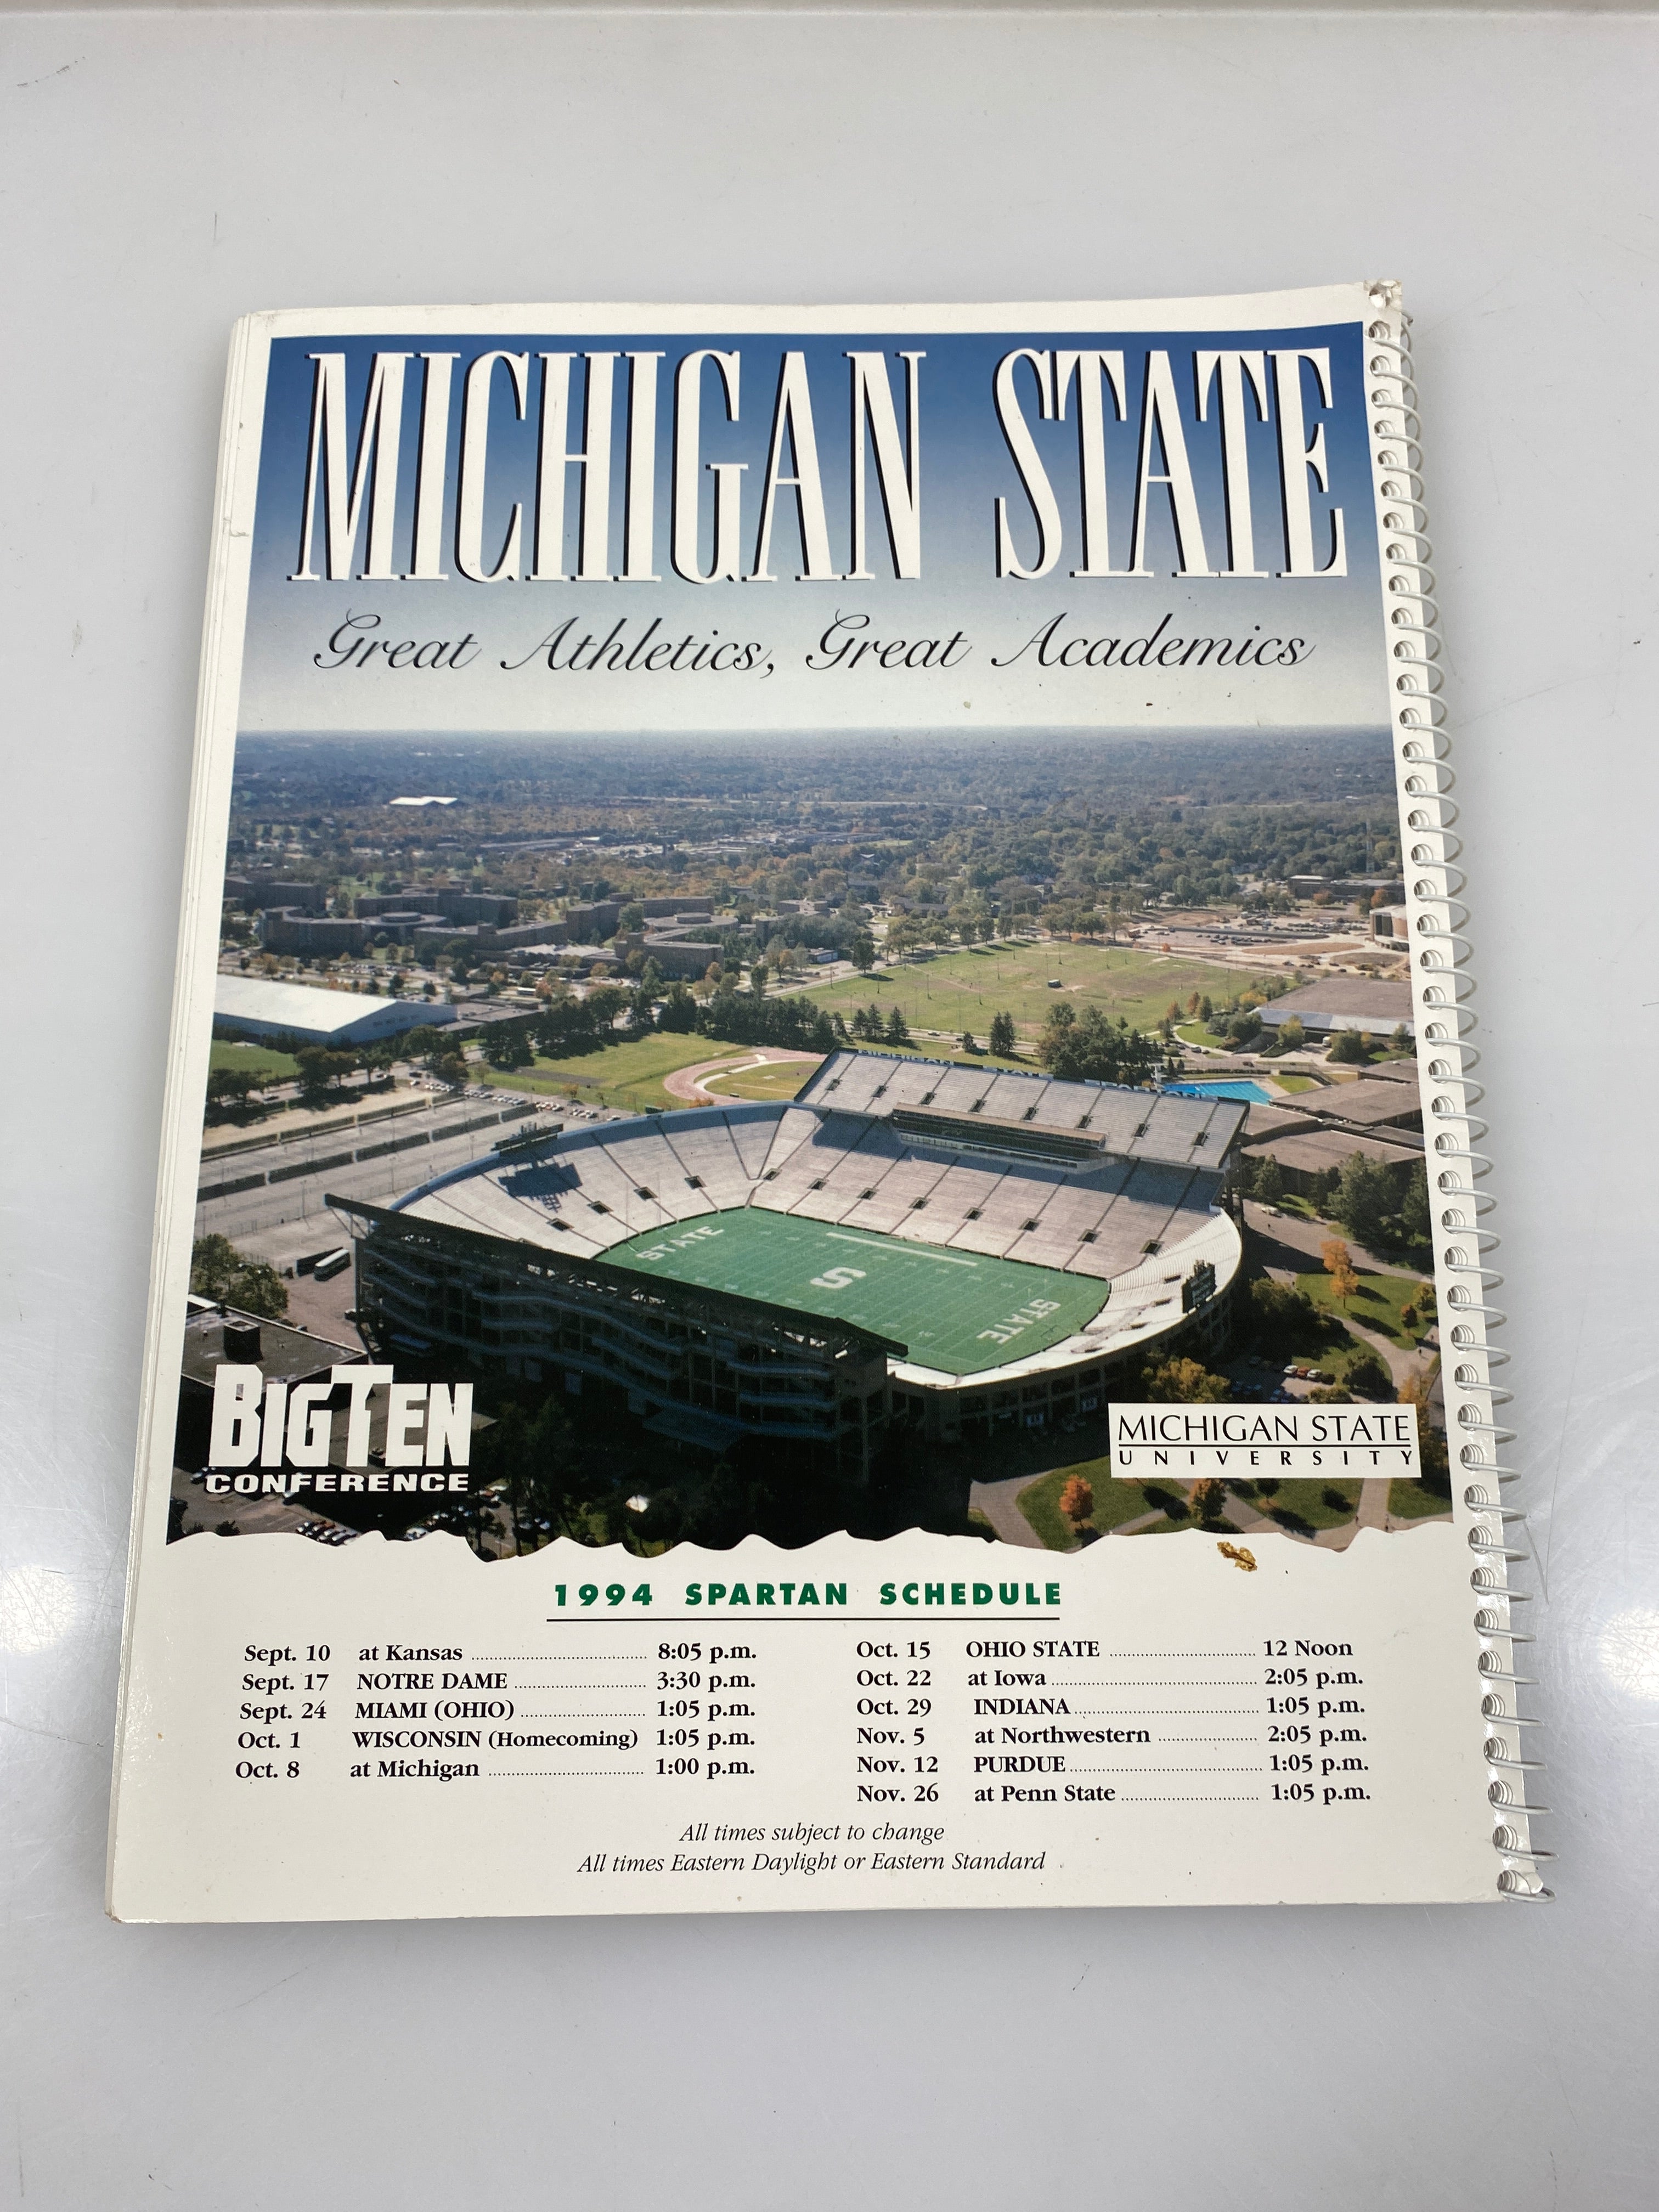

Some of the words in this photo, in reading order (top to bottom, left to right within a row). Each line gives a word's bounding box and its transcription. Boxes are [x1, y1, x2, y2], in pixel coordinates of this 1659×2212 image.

[286, 350, 927, 584] MICHIGAN
[992, 347, 1347, 580] STATE
[313, 608, 482, 669] Great
[500, 616, 775, 679] Athletics,
[805, 608, 972, 670] Great
[990, 612, 1316, 668] Academics
[635, 1225, 724, 1261] STATE
[976, 1298, 1062, 1345] STATE
[1119, 1415, 1297, 1441] MICHIGAN
[1312, 1415, 1409, 1441] STATE
[1120, 1451, 1412, 1465] UNIVERSITY
[205, 1473, 469, 1494] CONFERENCE
[555, 1584, 652, 1606] 1994
[685, 1583, 846, 1605] SPARTAN
[881, 1583, 1060, 1605] SCHEDULE
[245, 1645, 296, 1664] Sept.
[307, 1645, 330, 1661] 10
[359, 1646, 379, 1660] at
[386, 1645, 462, 1660] Kansas
[658, 1643, 701, 1661] 8:05
[709, 1647, 756, 1663] p.m.
[857, 1641, 898, 1657] Oct.
[907, 1641, 930, 1659] 15
[967, 1641, 1025, 1657] OHIO
[1034, 1641, 1099, 1657] STATE
[1264, 1640, 1287, 1656] 12
[1295, 1640, 1353, 1656] Noon
[242, 1674, 294, 1694] Sept.
[304, 1674, 329, 1691] 17
[357, 1673, 433, 1690] NOTRE
[442, 1673, 507, 1689] DAME
[657, 1672, 700, 1690] 3:30
[708, 1675, 755, 1692] p.m.
[857, 1670, 898, 1686] Oct.
[907, 1670, 930, 1685] 22
[968, 1672, 988, 1685] at
[995, 1671, 1046, 1685] Iowa
[1265, 1668, 1307, 1686] 2:05
[1316, 1672, 1363, 1689] p.m.
[240, 1703, 292, 1723] Sept.
[302, 1700, 326, 1719] 24
[355, 1702, 427, 1718] MIAMI
[435, 1700, 514, 1721] (OHIO)
[658, 1700, 699, 1718] 1:05
[708, 1704, 755, 1721] p.m.
[857, 1699, 898, 1714] Oct.
[907, 1699, 931, 1717] 29
[974, 1699, 1070, 1715] INDIANA
[1267, 1697, 1309, 1714] 1:05
[1318, 1701, 1364, 1718] p.m.
[238, 1732, 280, 1748] Oct.
[291, 1732, 300, 1748] 1
[352, 1731, 482, 1747] WISCONSIN
[489, 1730, 637, 1750] (Homecoming)
[657, 1729, 699, 1747] 1:05
[707, 1733, 754, 1750] p.m.
[857, 1728, 904, 1743] Nov.
[914, 1728, 924, 1745] 5
[975, 1729, 994, 1743] at
[1002, 1726, 1150, 1743] Northwestern
[1268, 1725, 1311, 1743] 2:05
[1319, 1729, 1367, 1747] p.m.
[236, 1762, 278, 1778] Oct.
[287, 1762, 299, 1778] 8
[351, 1762, 370, 1777] at
[377, 1759, 479, 1781] Michigan
[656, 1758, 699, 1774] 1:00
[707, 1762, 754, 1779] p.m.
[857, 1757, 905, 1773] Nov.
[915, 1757, 938, 1772] 12
[974, 1756, 1065, 1772] PURDUE
[1270, 1754, 1312, 1773] 1:05
[1321, 1758, 1368, 1775] p.m.
[857, 1786, 905, 1802] Nov.
[915, 1783, 938, 1802] 26
[975, 1787, 994, 1801] at
[1001, 1786, 1057, 1801] Penn
[1065, 1785, 1115, 1801] State
[1272, 1784, 1314, 1802] 1:05
[1323, 1787, 1370, 1805] p.m.
[679, 1823, 708, 1841] All
[715, 1825, 765, 1841] times
[772, 1822, 840, 1846] subject
[848, 1825, 864, 1839] to
[873, 1822, 944, 1845] change
[577, 1854, 606, 1872] All
[613, 1855, 664, 1871] times
[671, 1855, 744, 1871] Eastern
[752, 1852, 837, 1875] Daylight
[844, 1858, 866, 1869] or
[871, 1853, 944, 1869] Eastern
[952, 1852, 1045, 1869] Standard
